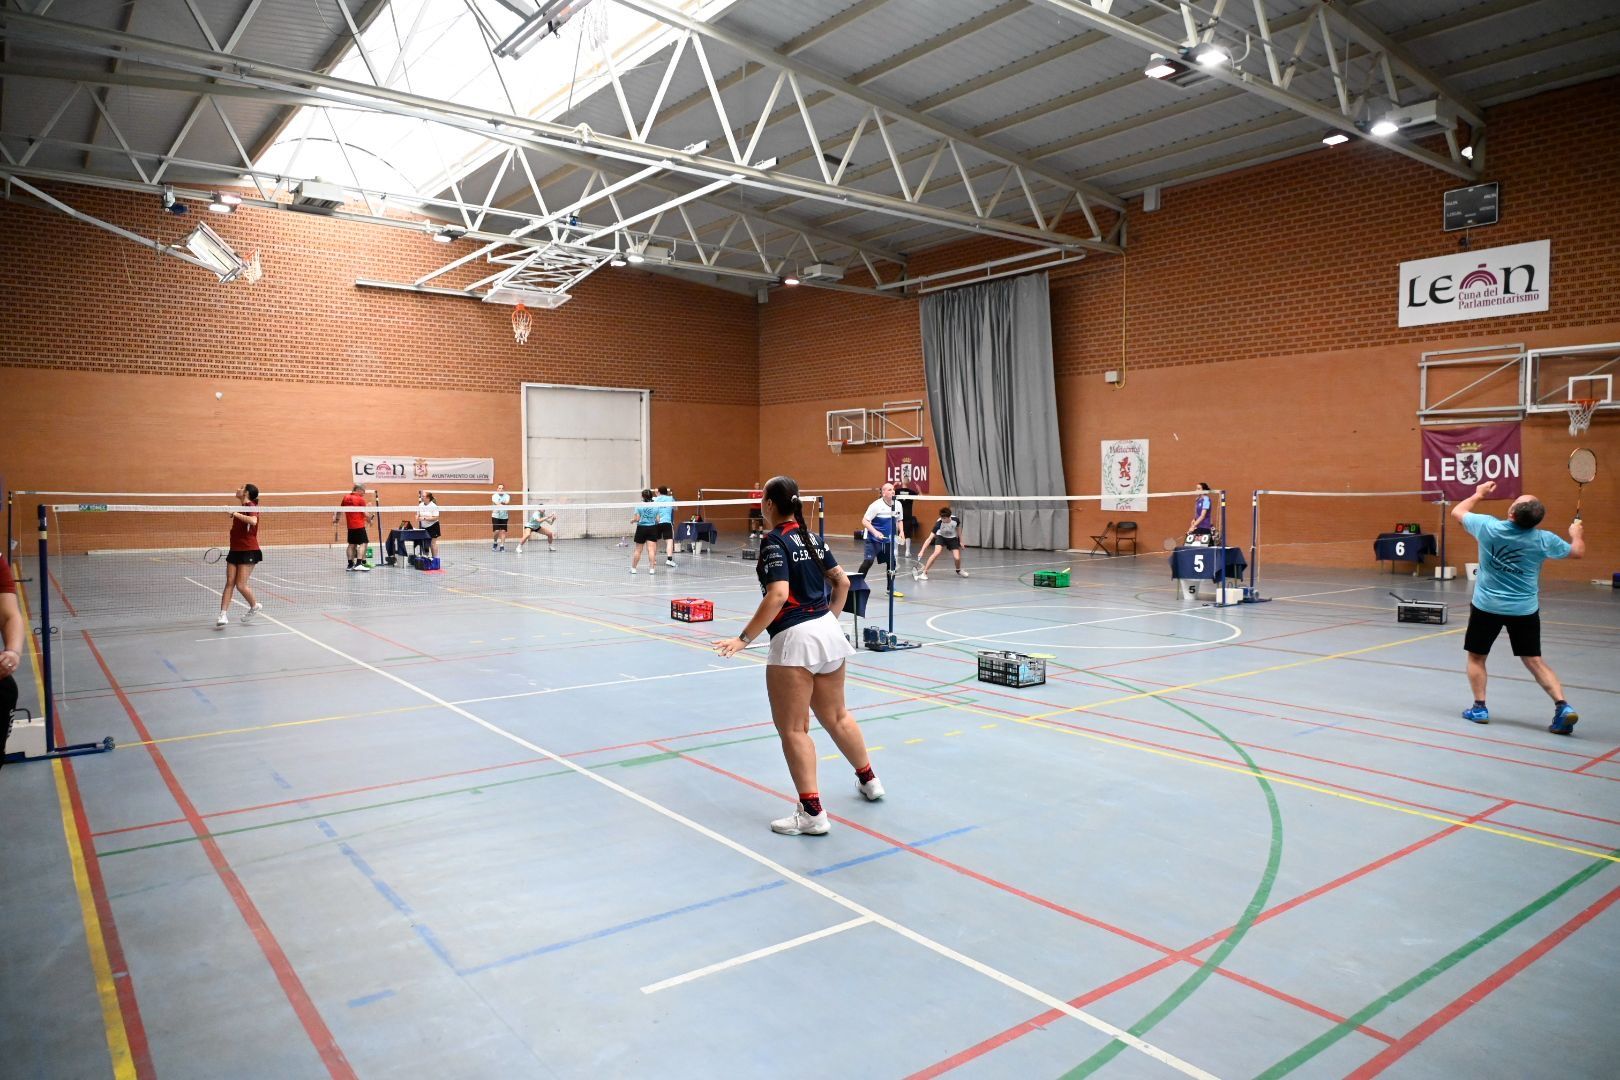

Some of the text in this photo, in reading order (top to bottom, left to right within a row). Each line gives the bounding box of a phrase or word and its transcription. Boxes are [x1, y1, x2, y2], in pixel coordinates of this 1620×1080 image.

[1458, 287, 1498, 301] Cuna del
[1458, 293, 1540, 310] Parlamentarismo
[1186, 534, 1194, 543] 0
[1200, 534, 1209, 543] 0
[1395, 541, 1405, 556] 6
[1194, 554, 1204, 573] 5
[1188, 585, 1196, 594] 5
